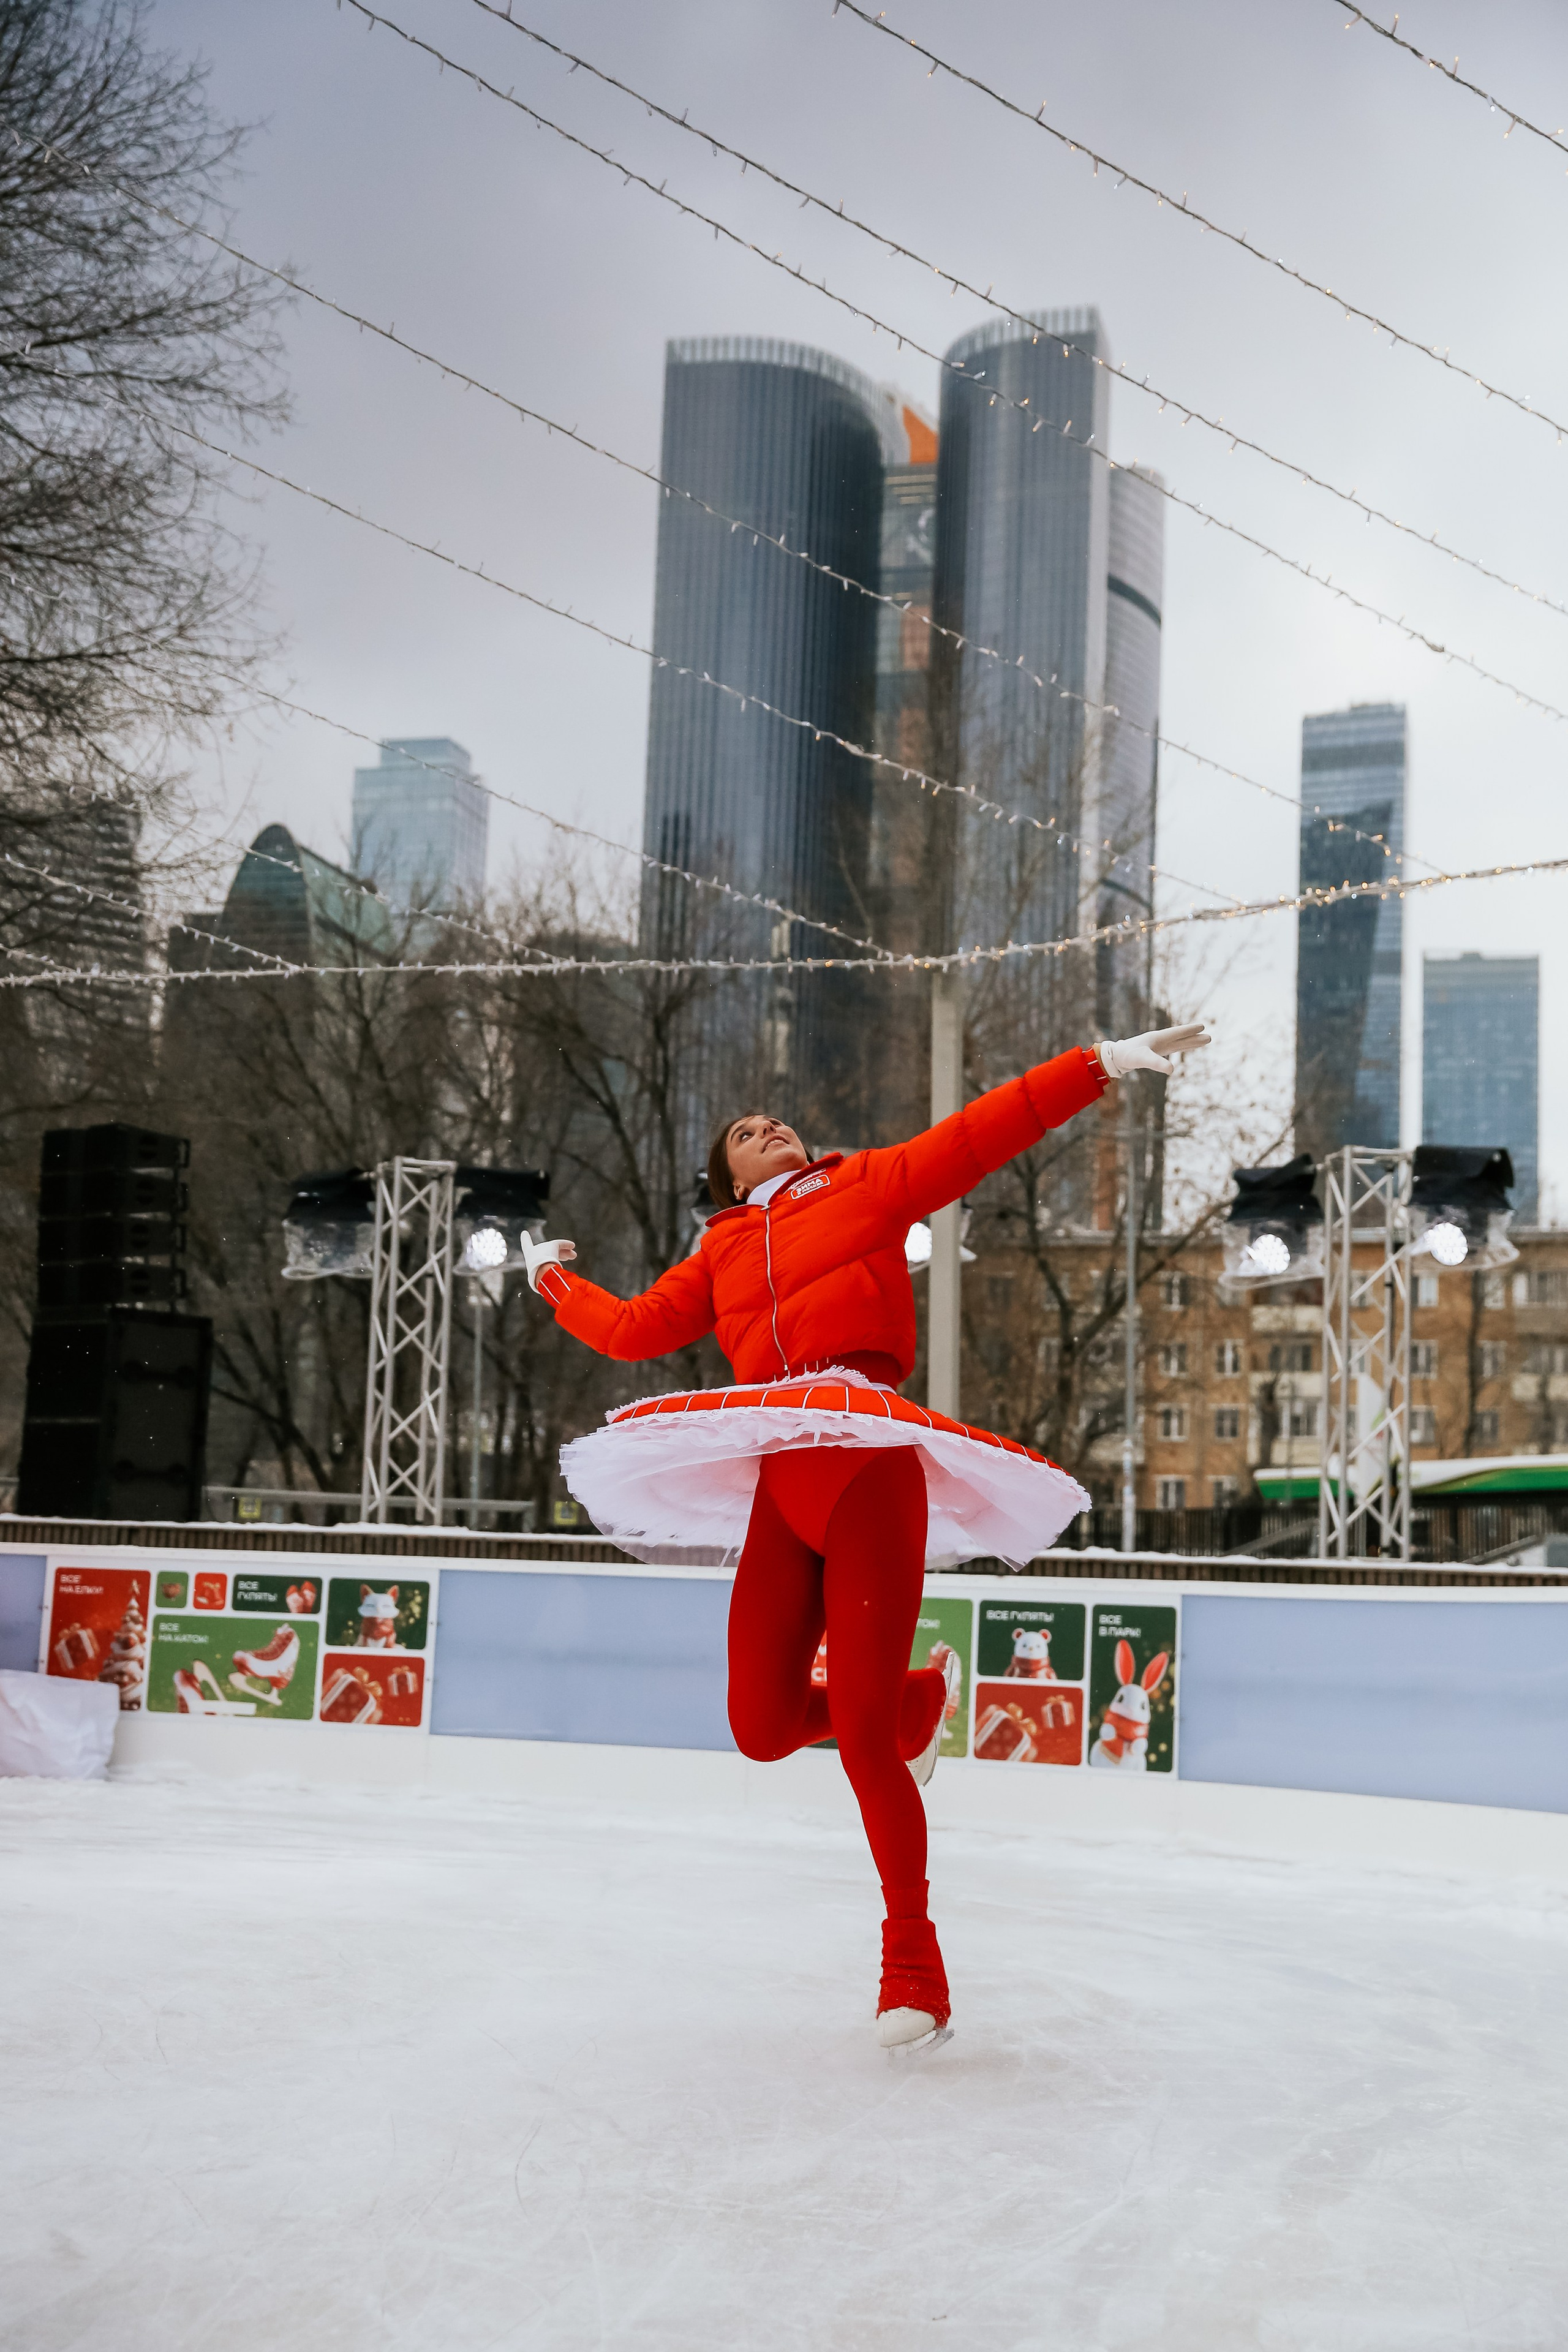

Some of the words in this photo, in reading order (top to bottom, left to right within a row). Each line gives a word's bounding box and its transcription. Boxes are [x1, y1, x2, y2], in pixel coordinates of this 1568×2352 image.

[796, 1178, 822, 1193] ЗИМА
[802, 1182, 824, 1193] МОСКВЕ
[61, 1575, 81, 1583] ВСЕ
[238, 1581, 258, 1590] ВСЕ
[986, 1610, 1009, 1620] ВСЕ
[1099, 1615, 1121, 1625] ВСЕ
[159, 1623, 179, 1632] ВСЕ
[1099, 1626, 1107, 1637] В
[1107, 1627, 1141, 1638] ПАРК!
